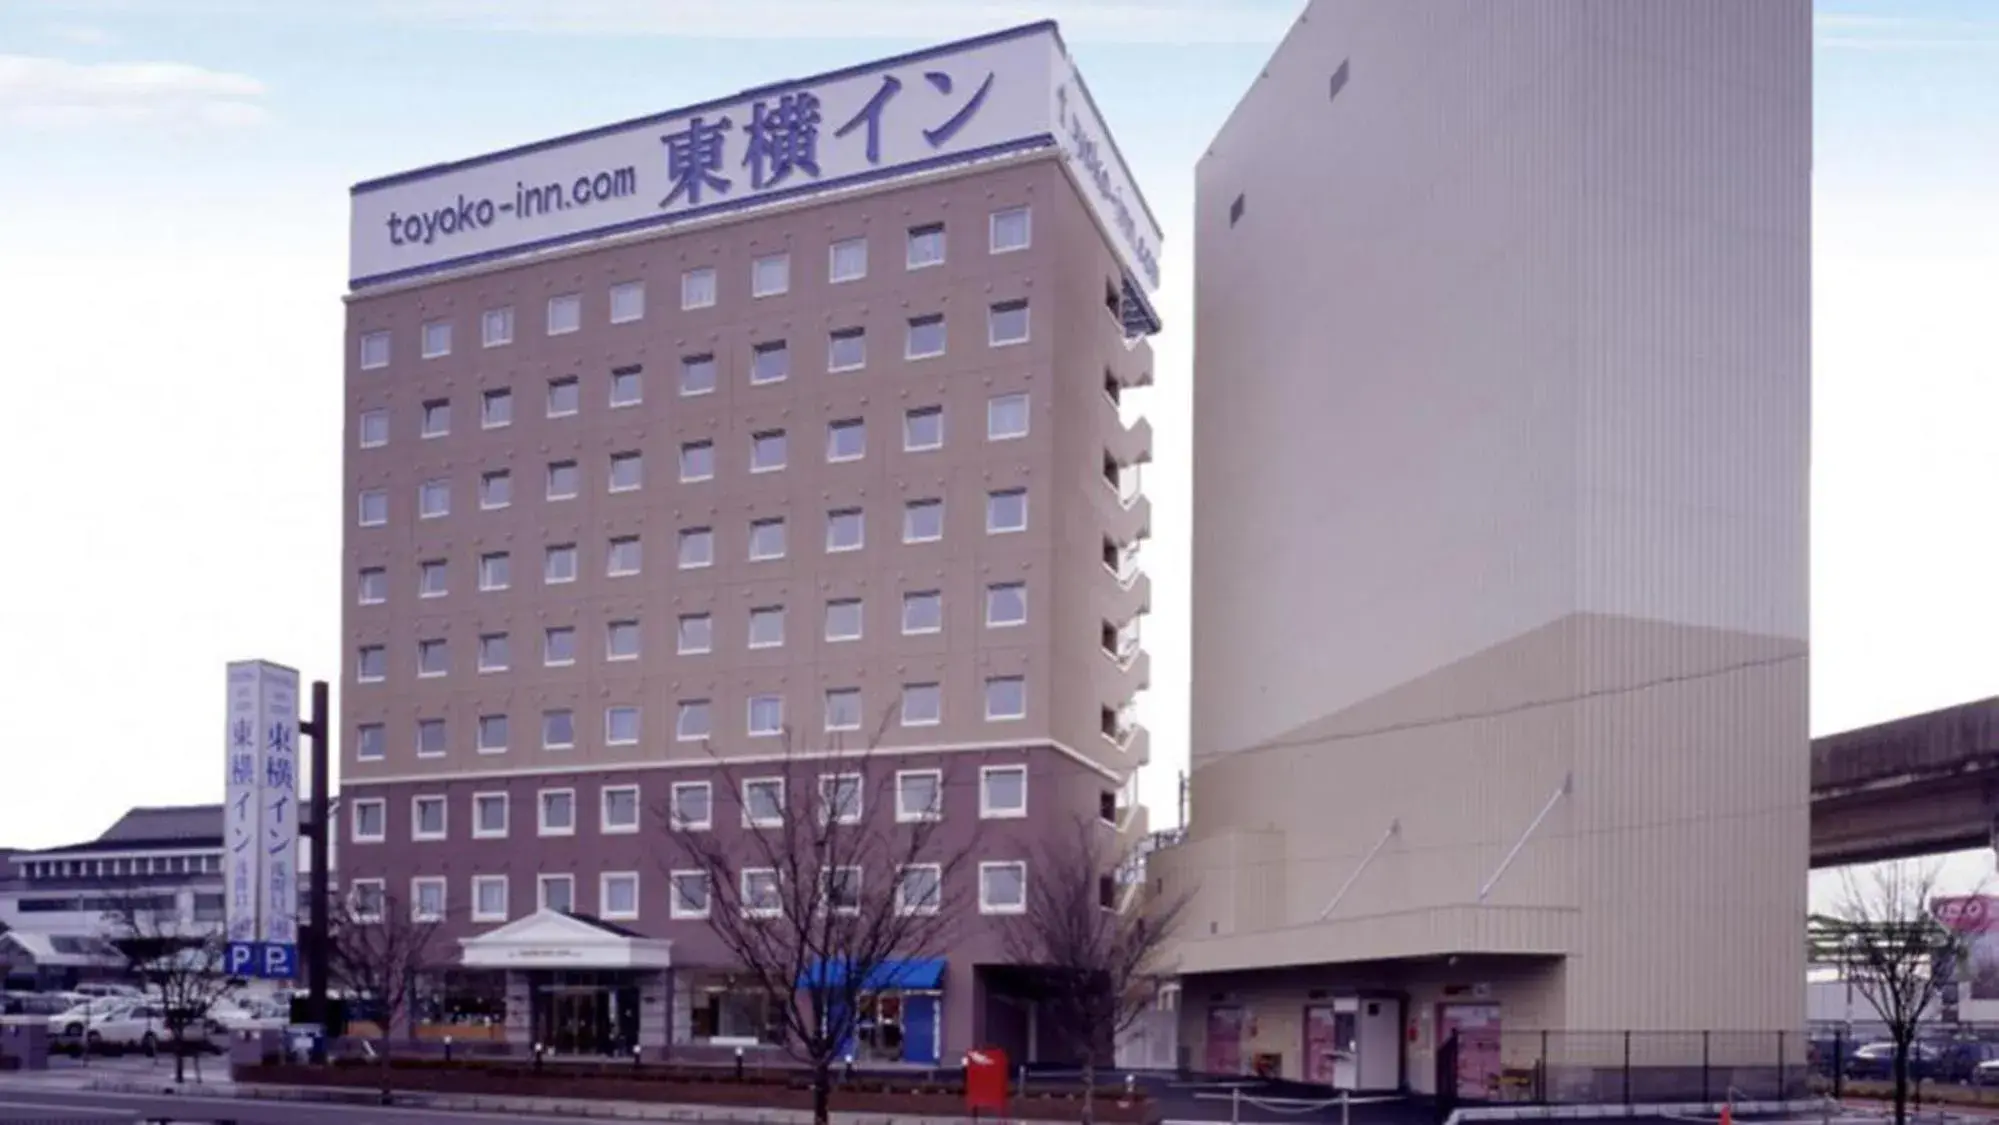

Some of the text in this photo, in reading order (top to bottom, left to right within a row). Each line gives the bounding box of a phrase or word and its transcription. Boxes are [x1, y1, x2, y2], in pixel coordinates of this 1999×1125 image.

[387, 165, 636, 246] toyoko-inn.com
[658, 71, 995, 208] 東横イン
[232, 716, 254, 854] 東横イン
[266, 719, 293, 857] 東横イン
[232, 945, 251, 974] P
